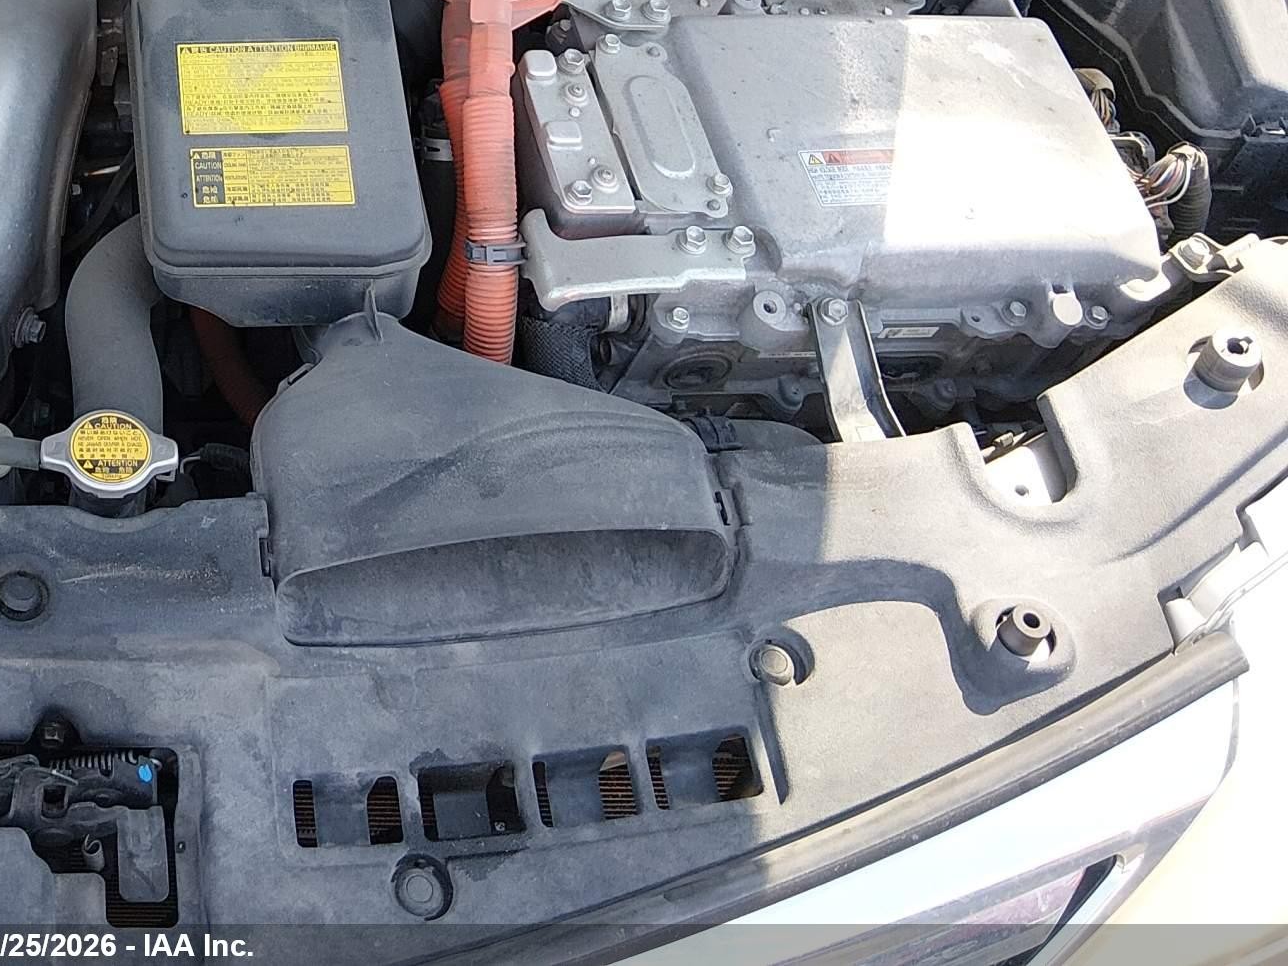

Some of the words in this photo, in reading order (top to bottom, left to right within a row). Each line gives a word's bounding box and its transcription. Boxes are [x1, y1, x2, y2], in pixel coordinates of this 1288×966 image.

[209, 45, 245, 53] CAUTION
[195, 161, 222, 170] CAUTION
[196, 174, 223, 182] ATTENTION
